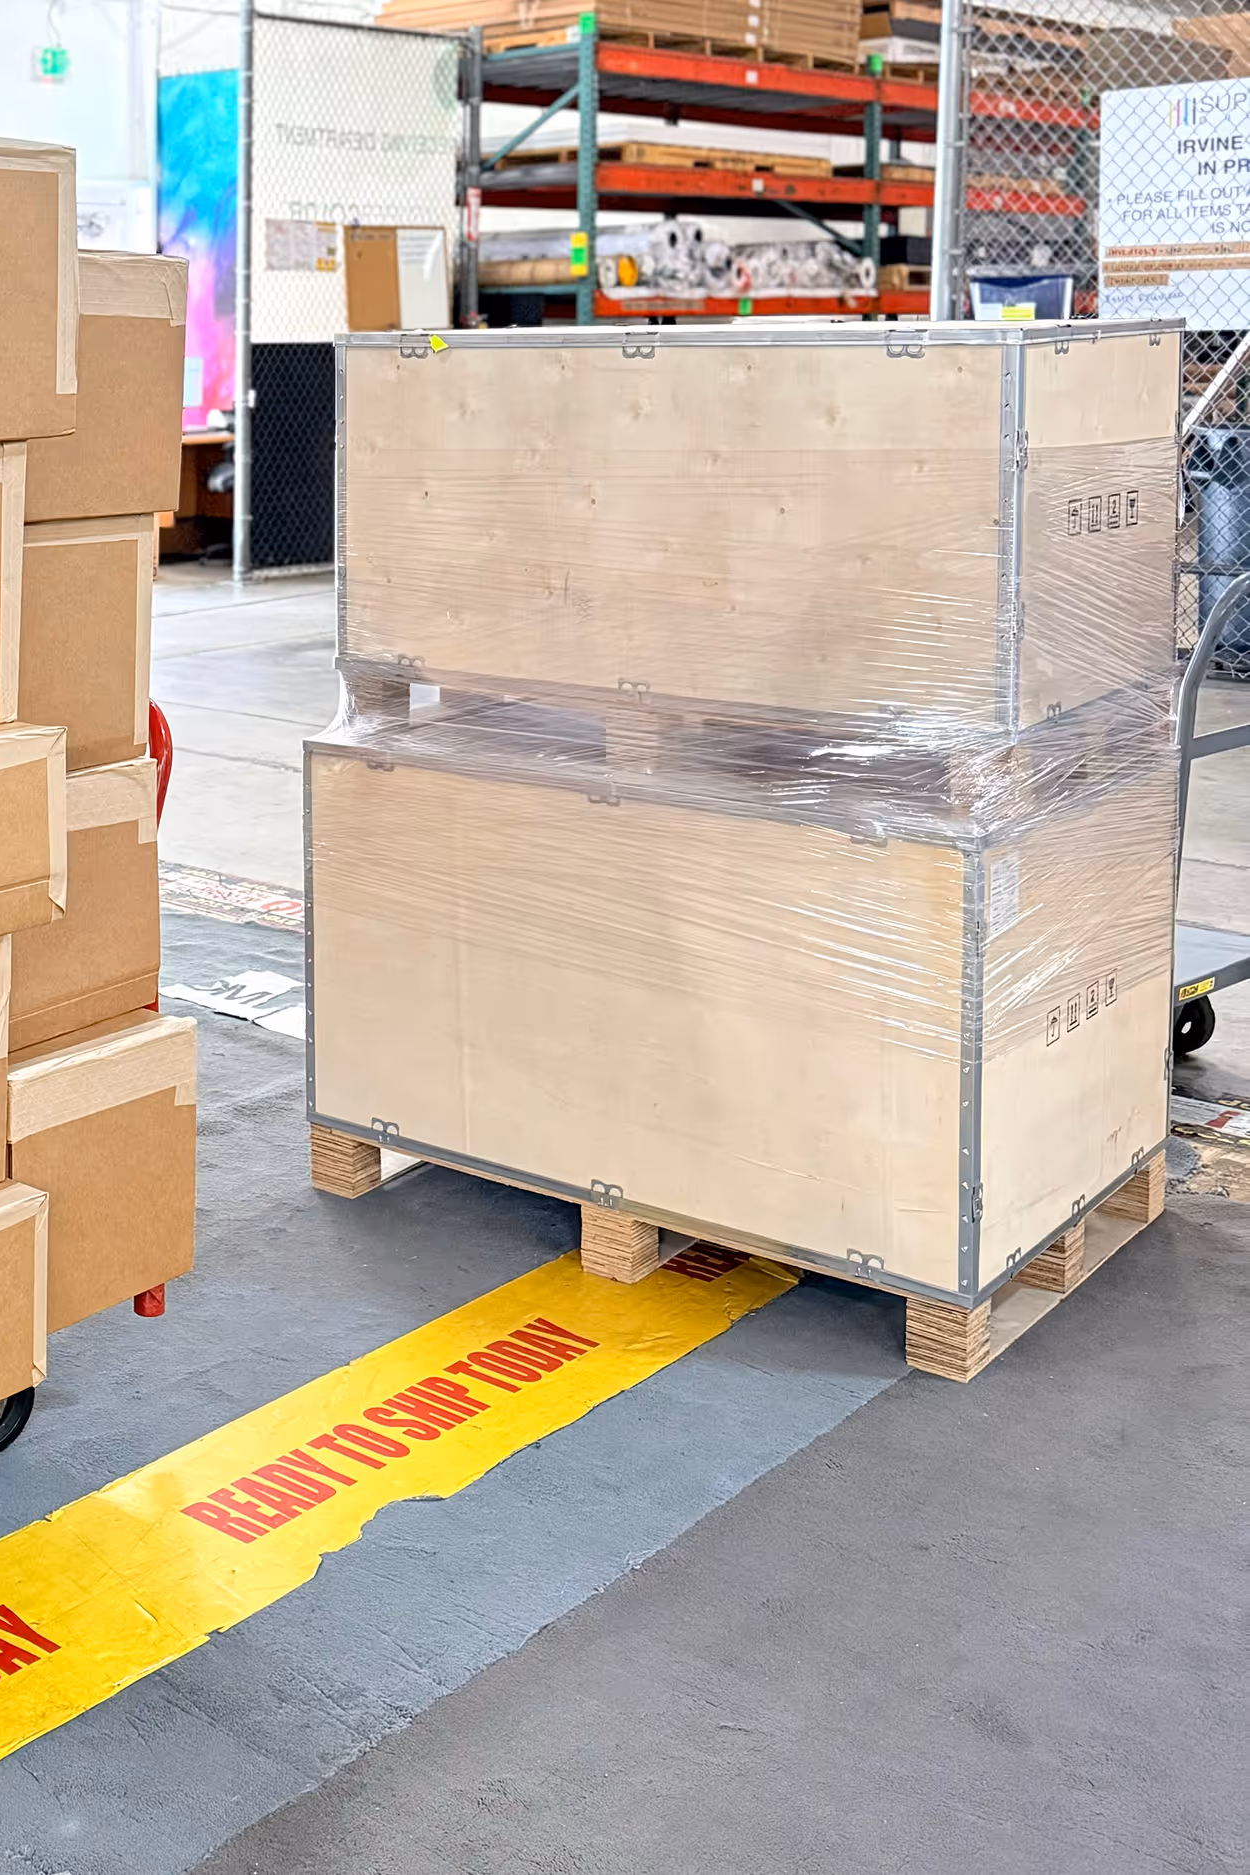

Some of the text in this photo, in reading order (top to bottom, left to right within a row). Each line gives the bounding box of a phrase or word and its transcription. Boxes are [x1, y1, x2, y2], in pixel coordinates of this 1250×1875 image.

[1200, 91, 1250, 113] SUP
[1177, 135, 1243, 155] IRVINE
[1197, 160, 1217, 176] IN
[1116, 191, 1173, 206] PLEASE
[1177, 189, 1207, 201] FILL
[1210, 186, 1242, 199] OUT
[1122, 209, 1153, 222] FOR
[1156, 207, 1182, 220] ALL
[1186, 204, 1232, 217] ITEMS
[180, 1317, 601, 1544] READY TO SHIP TODAY
